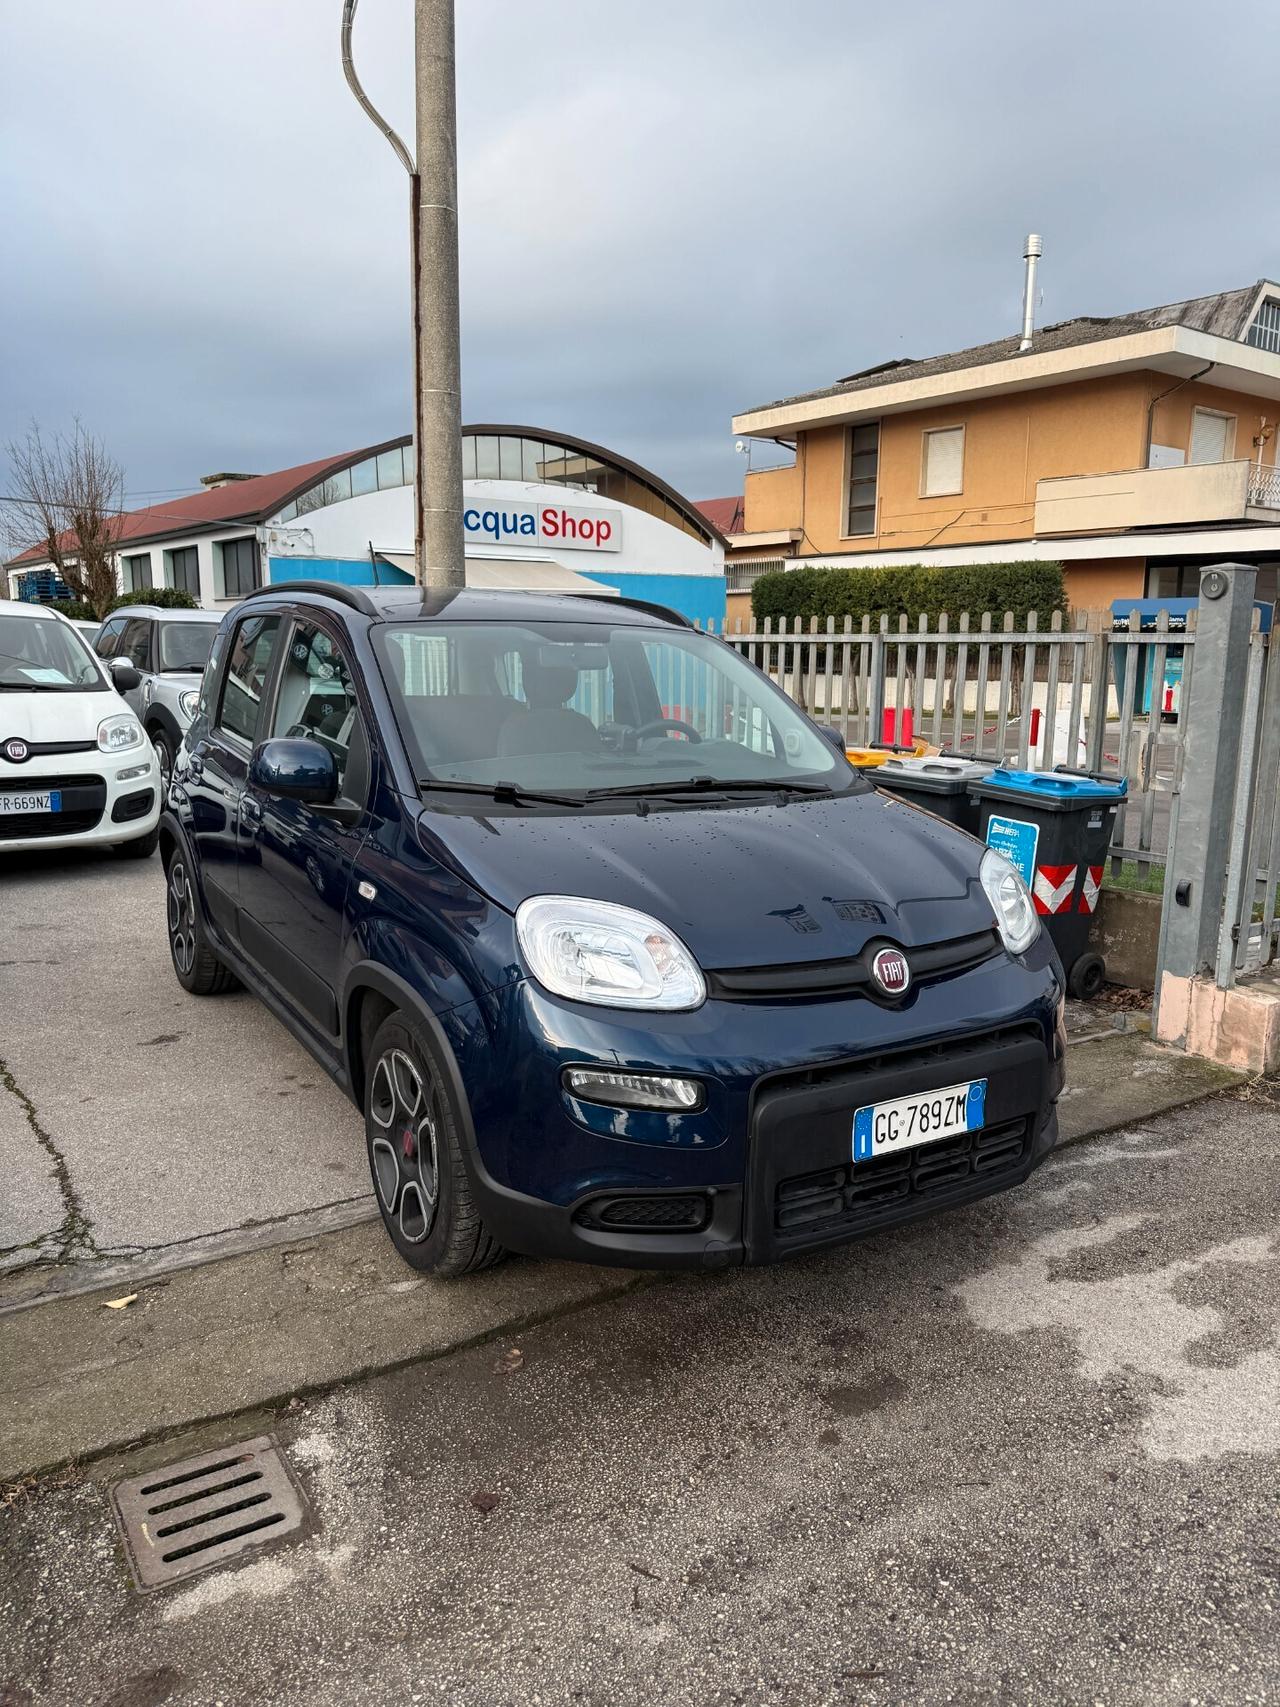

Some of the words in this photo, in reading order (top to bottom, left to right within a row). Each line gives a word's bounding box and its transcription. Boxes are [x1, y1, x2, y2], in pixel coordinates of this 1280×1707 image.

[463, 509, 536, 540] cqua
[542, 509, 612, 547] Shop
[881, 961, 903, 983] FIAT
